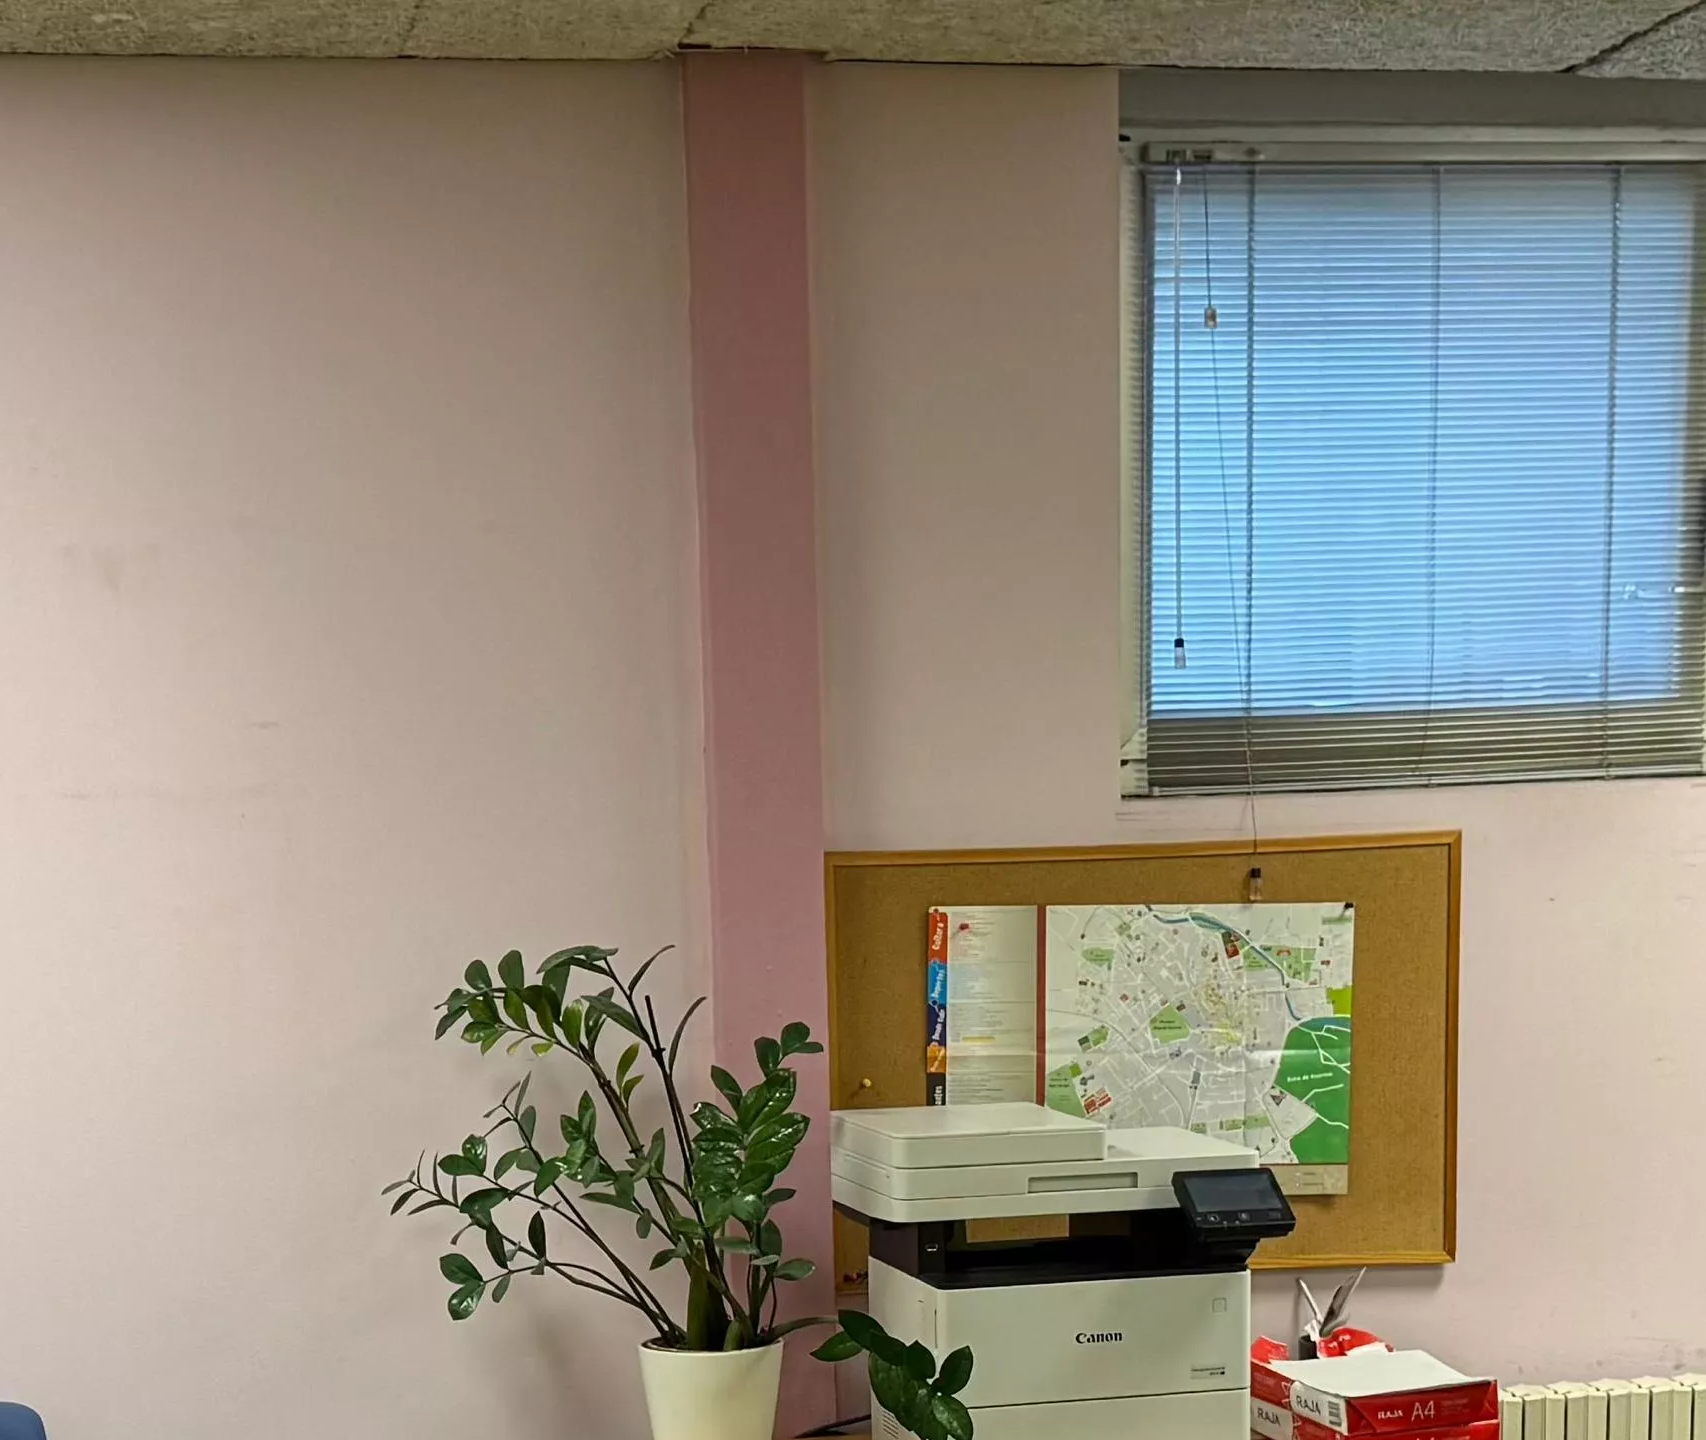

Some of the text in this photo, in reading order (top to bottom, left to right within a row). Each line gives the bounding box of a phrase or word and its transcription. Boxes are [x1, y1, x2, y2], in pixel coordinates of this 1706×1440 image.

[1075, 1332, 1123, 1344] Canon
[1295, 1395, 1321, 1415] RAJA
[1411, 1400, 1436, 1421] A4
[1256, 1407, 1281, 1427] RAJA
